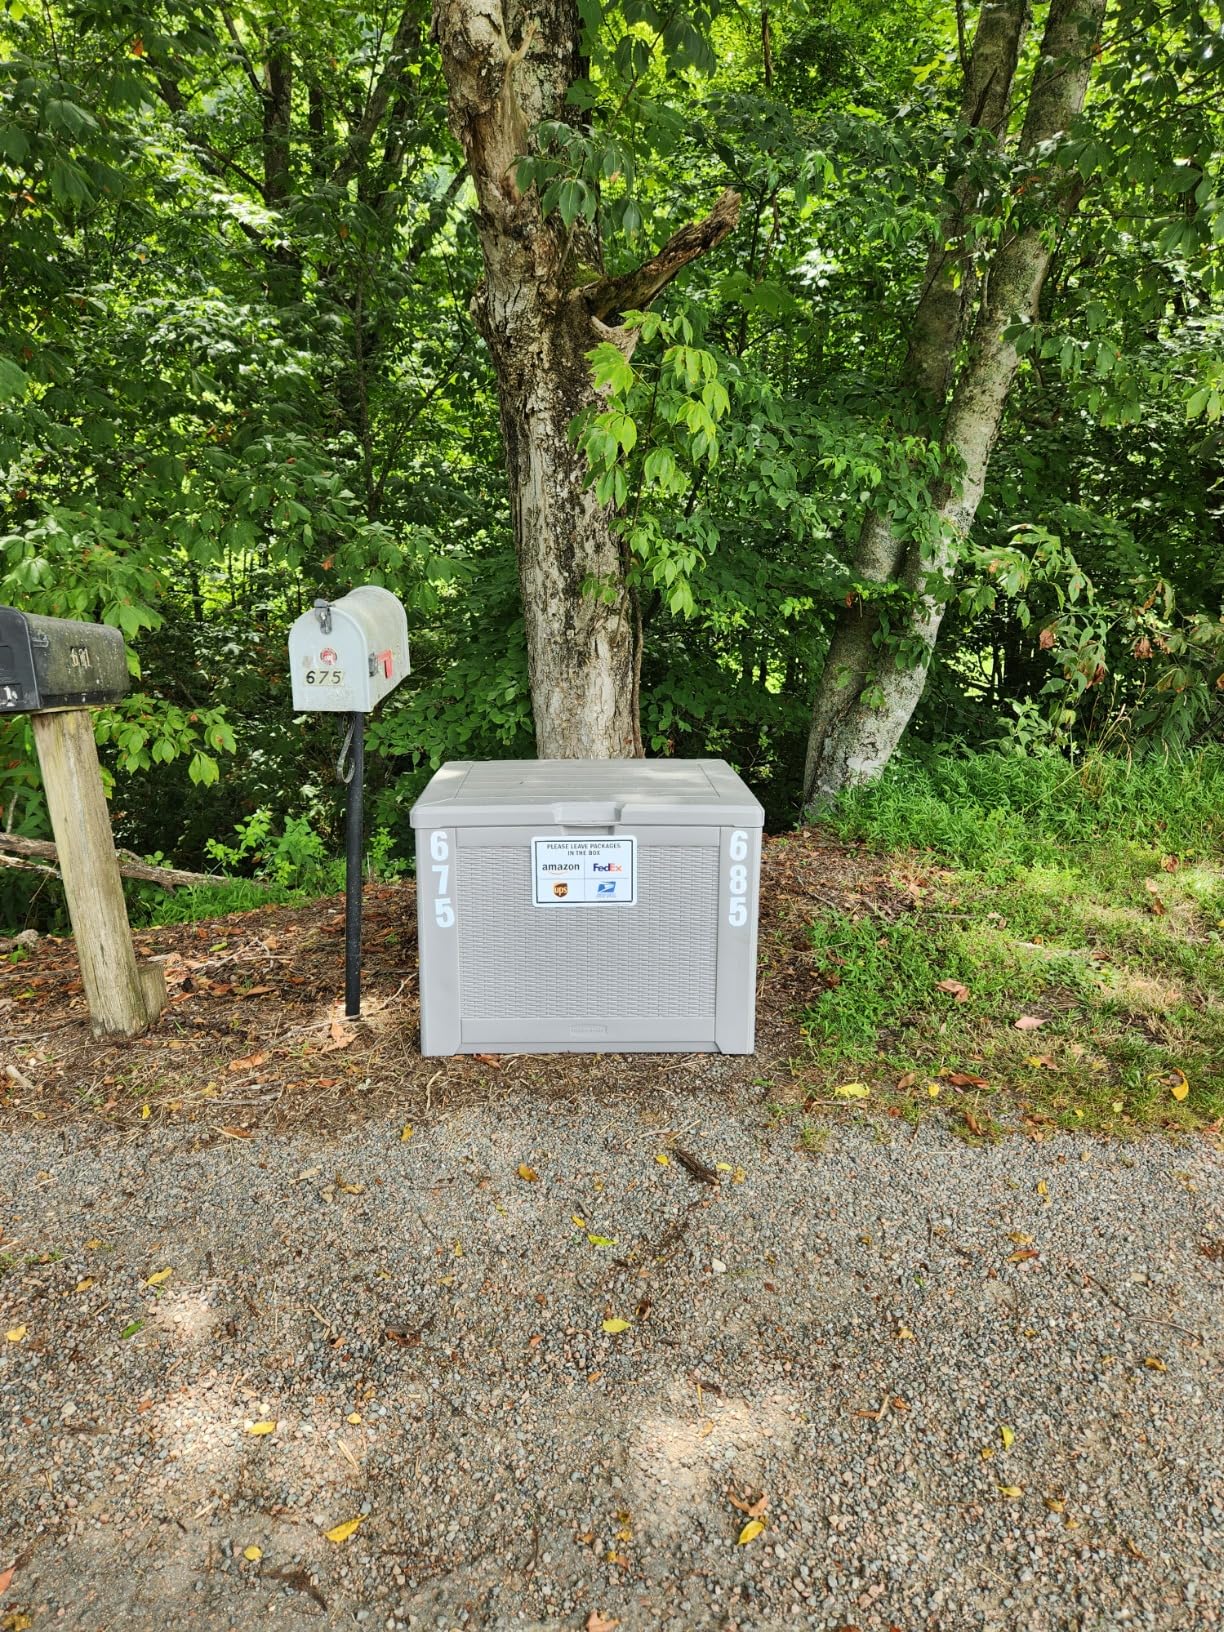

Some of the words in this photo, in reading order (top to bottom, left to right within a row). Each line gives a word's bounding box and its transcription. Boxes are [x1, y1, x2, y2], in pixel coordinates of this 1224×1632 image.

[306, 670, 342, 684] 675
[542, 863, 580, 871] amazon
[593, 863, 622, 872] FedEx
[430, 830, 455, 928] 675
[728, 830, 749, 927] 685
[554, 886, 568, 896] ups
